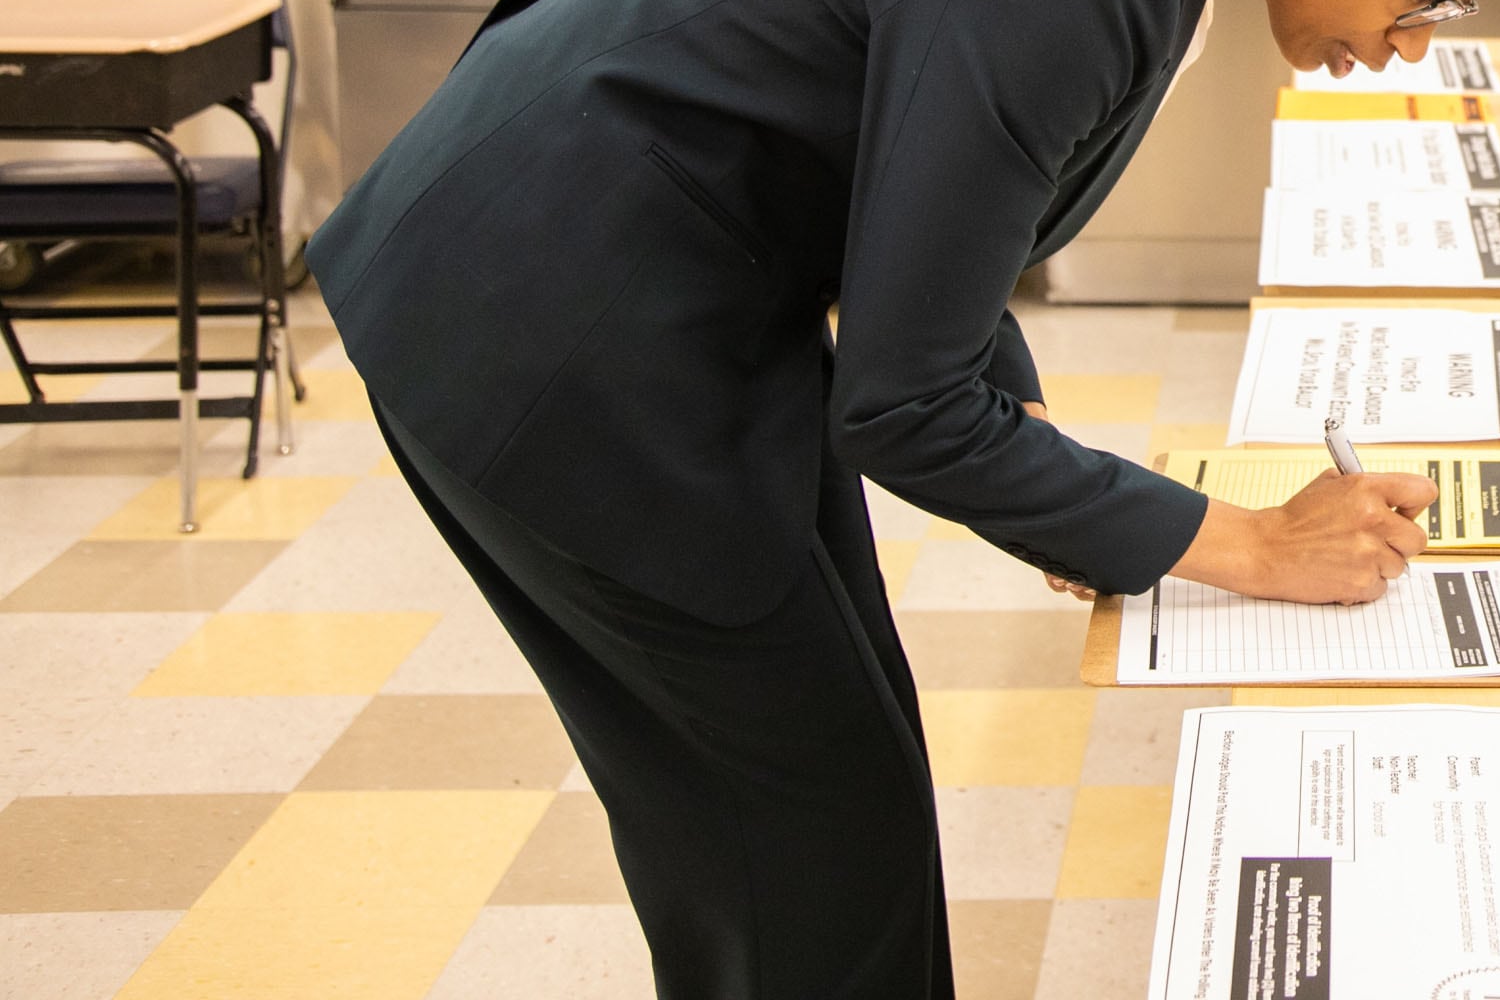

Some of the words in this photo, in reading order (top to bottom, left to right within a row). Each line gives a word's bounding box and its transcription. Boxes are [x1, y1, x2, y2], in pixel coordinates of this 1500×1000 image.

[1448, 354, 1474, 398] WARNING
[1223, 731, 1234, 751] Election
[1218, 752, 1232, 771] Judges
[1218, 772, 1230, 791] Should
[1388, 756, 1402, 795] Non-Teacher
[1217, 792, 1229, 804] Post
[1215, 804, 1228, 815] This
[1213, 816, 1226, 835] Notice
[1211, 837, 1224, 856] Where
[1208, 864, 1220, 877] May
[1208, 879, 1220, 887] Be
[1286, 877, 1303, 897] Bring
[1207, 888, 1219, 905] Seen
[1288, 897, 1302, 912] Two
[1308, 895, 1322, 915] Proof
[1206, 907, 1217, 916] As
[1308, 916, 1322, 924] of
[1203, 918, 1216, 939] Voters
[1287, 913, 1302, 934] Items
[1201, 940, 1215, 958] Enter
[1287, 935, 1301, 944] of
[1306, 926, 1322, 977] Identification
[1200, 959, 1213, 972] The
[1285, 944, 1300, 997] Identification
[1194, 974, 1210, 999] Polling
